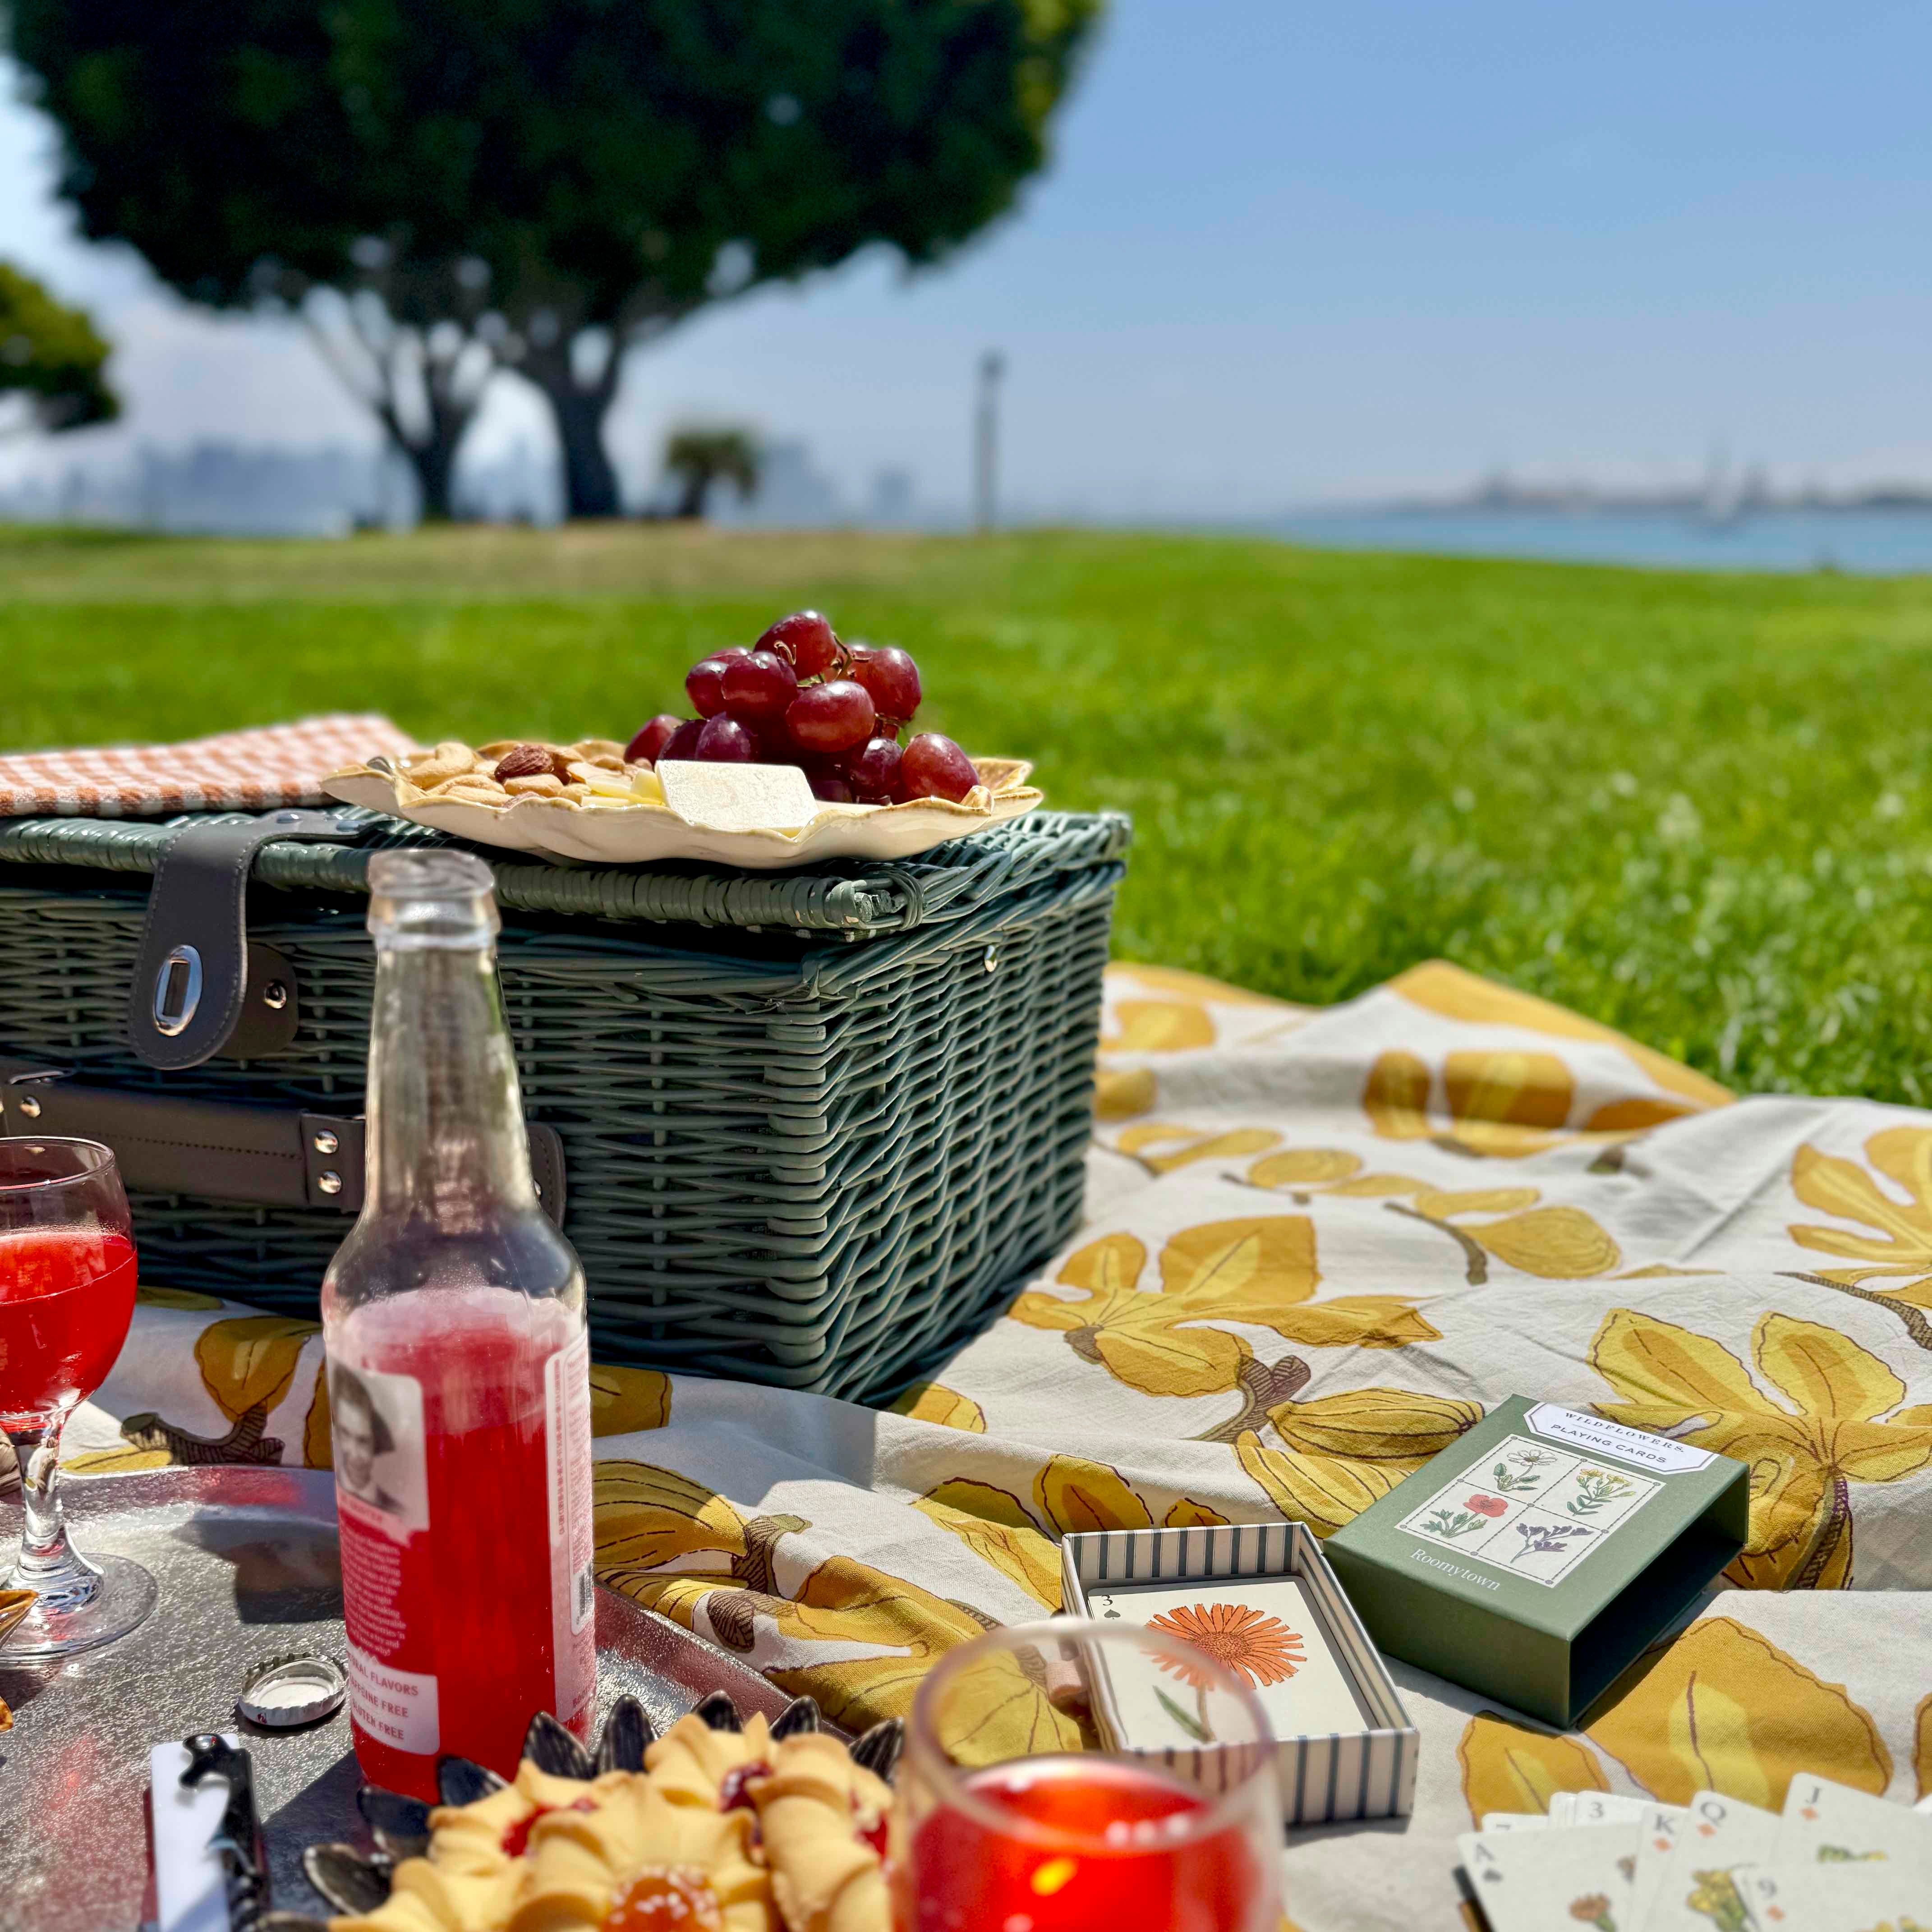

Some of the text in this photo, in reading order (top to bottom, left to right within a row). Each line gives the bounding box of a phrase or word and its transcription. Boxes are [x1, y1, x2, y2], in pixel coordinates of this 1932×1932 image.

[1550, 1424, 1667, 1463] PLAYING CARDS
[1410, 1548, 1500, 1591] Roomytown
[1101, 1594, 1113, 1606] 3
[371, 1671, 419, 1696] FLAVORS
[382, 1701, 409, 1718] FREE
[378, 1722, 404, 1739] FREE
[1589, 1802, 1603, 1818] 3
[1700, 1801, 1727, 1827] Q
[1654, 1813, 1675, 1835] K
[1473, 1842, 1496, 1862] A
